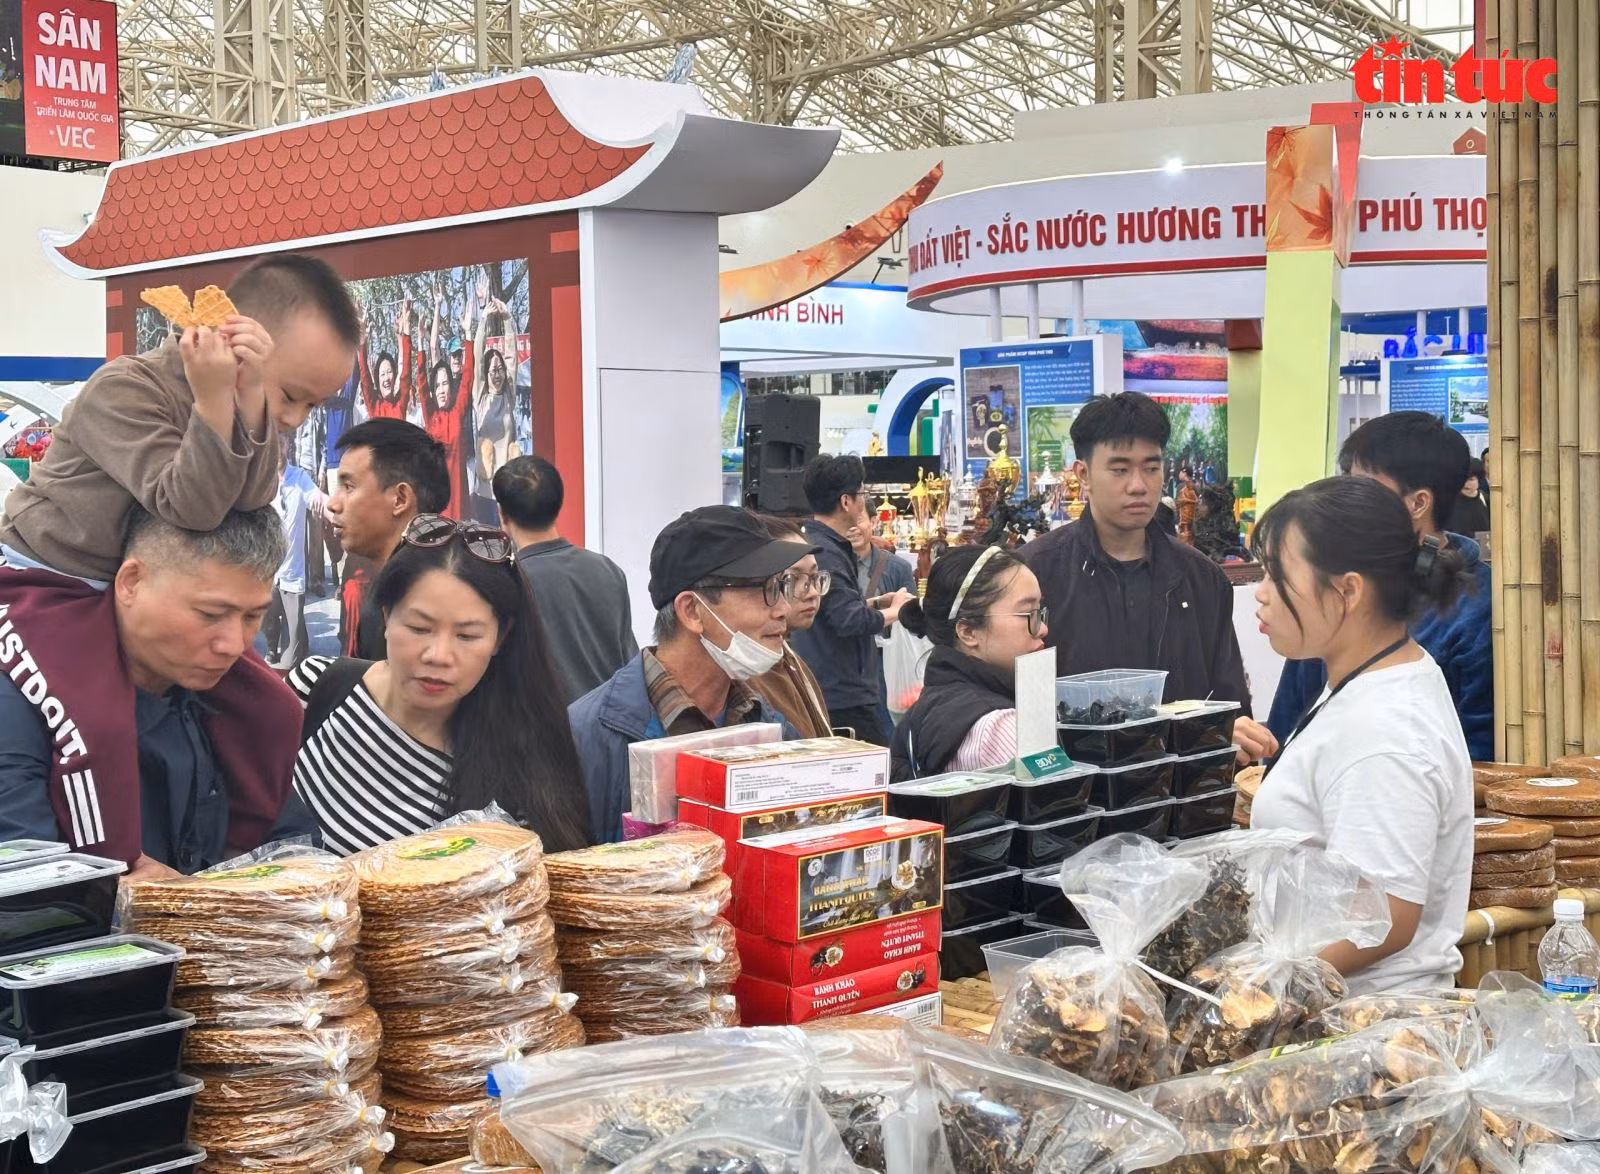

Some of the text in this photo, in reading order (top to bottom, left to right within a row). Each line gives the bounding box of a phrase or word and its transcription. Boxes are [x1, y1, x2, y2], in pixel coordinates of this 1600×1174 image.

[37, 8, 101, 51] SÂN
[34, 54, 107, 95] NAM
[53, 96, 97, 110] TRUNG TÂM
[55, 124, 96, 150] VEC
[941, 225, 971, 268] VIỆT
[987, 212, 1029, 255] SẮC
[1036, 208, 1107, 249] NƯỚC
[1116, 205, 1221, 244] HƯƠNG
[1231, 203, 1266, 238] TH
[1359, 191, 1423, 232] PHÚ
[797, 295, 844, 325] BÌNH
